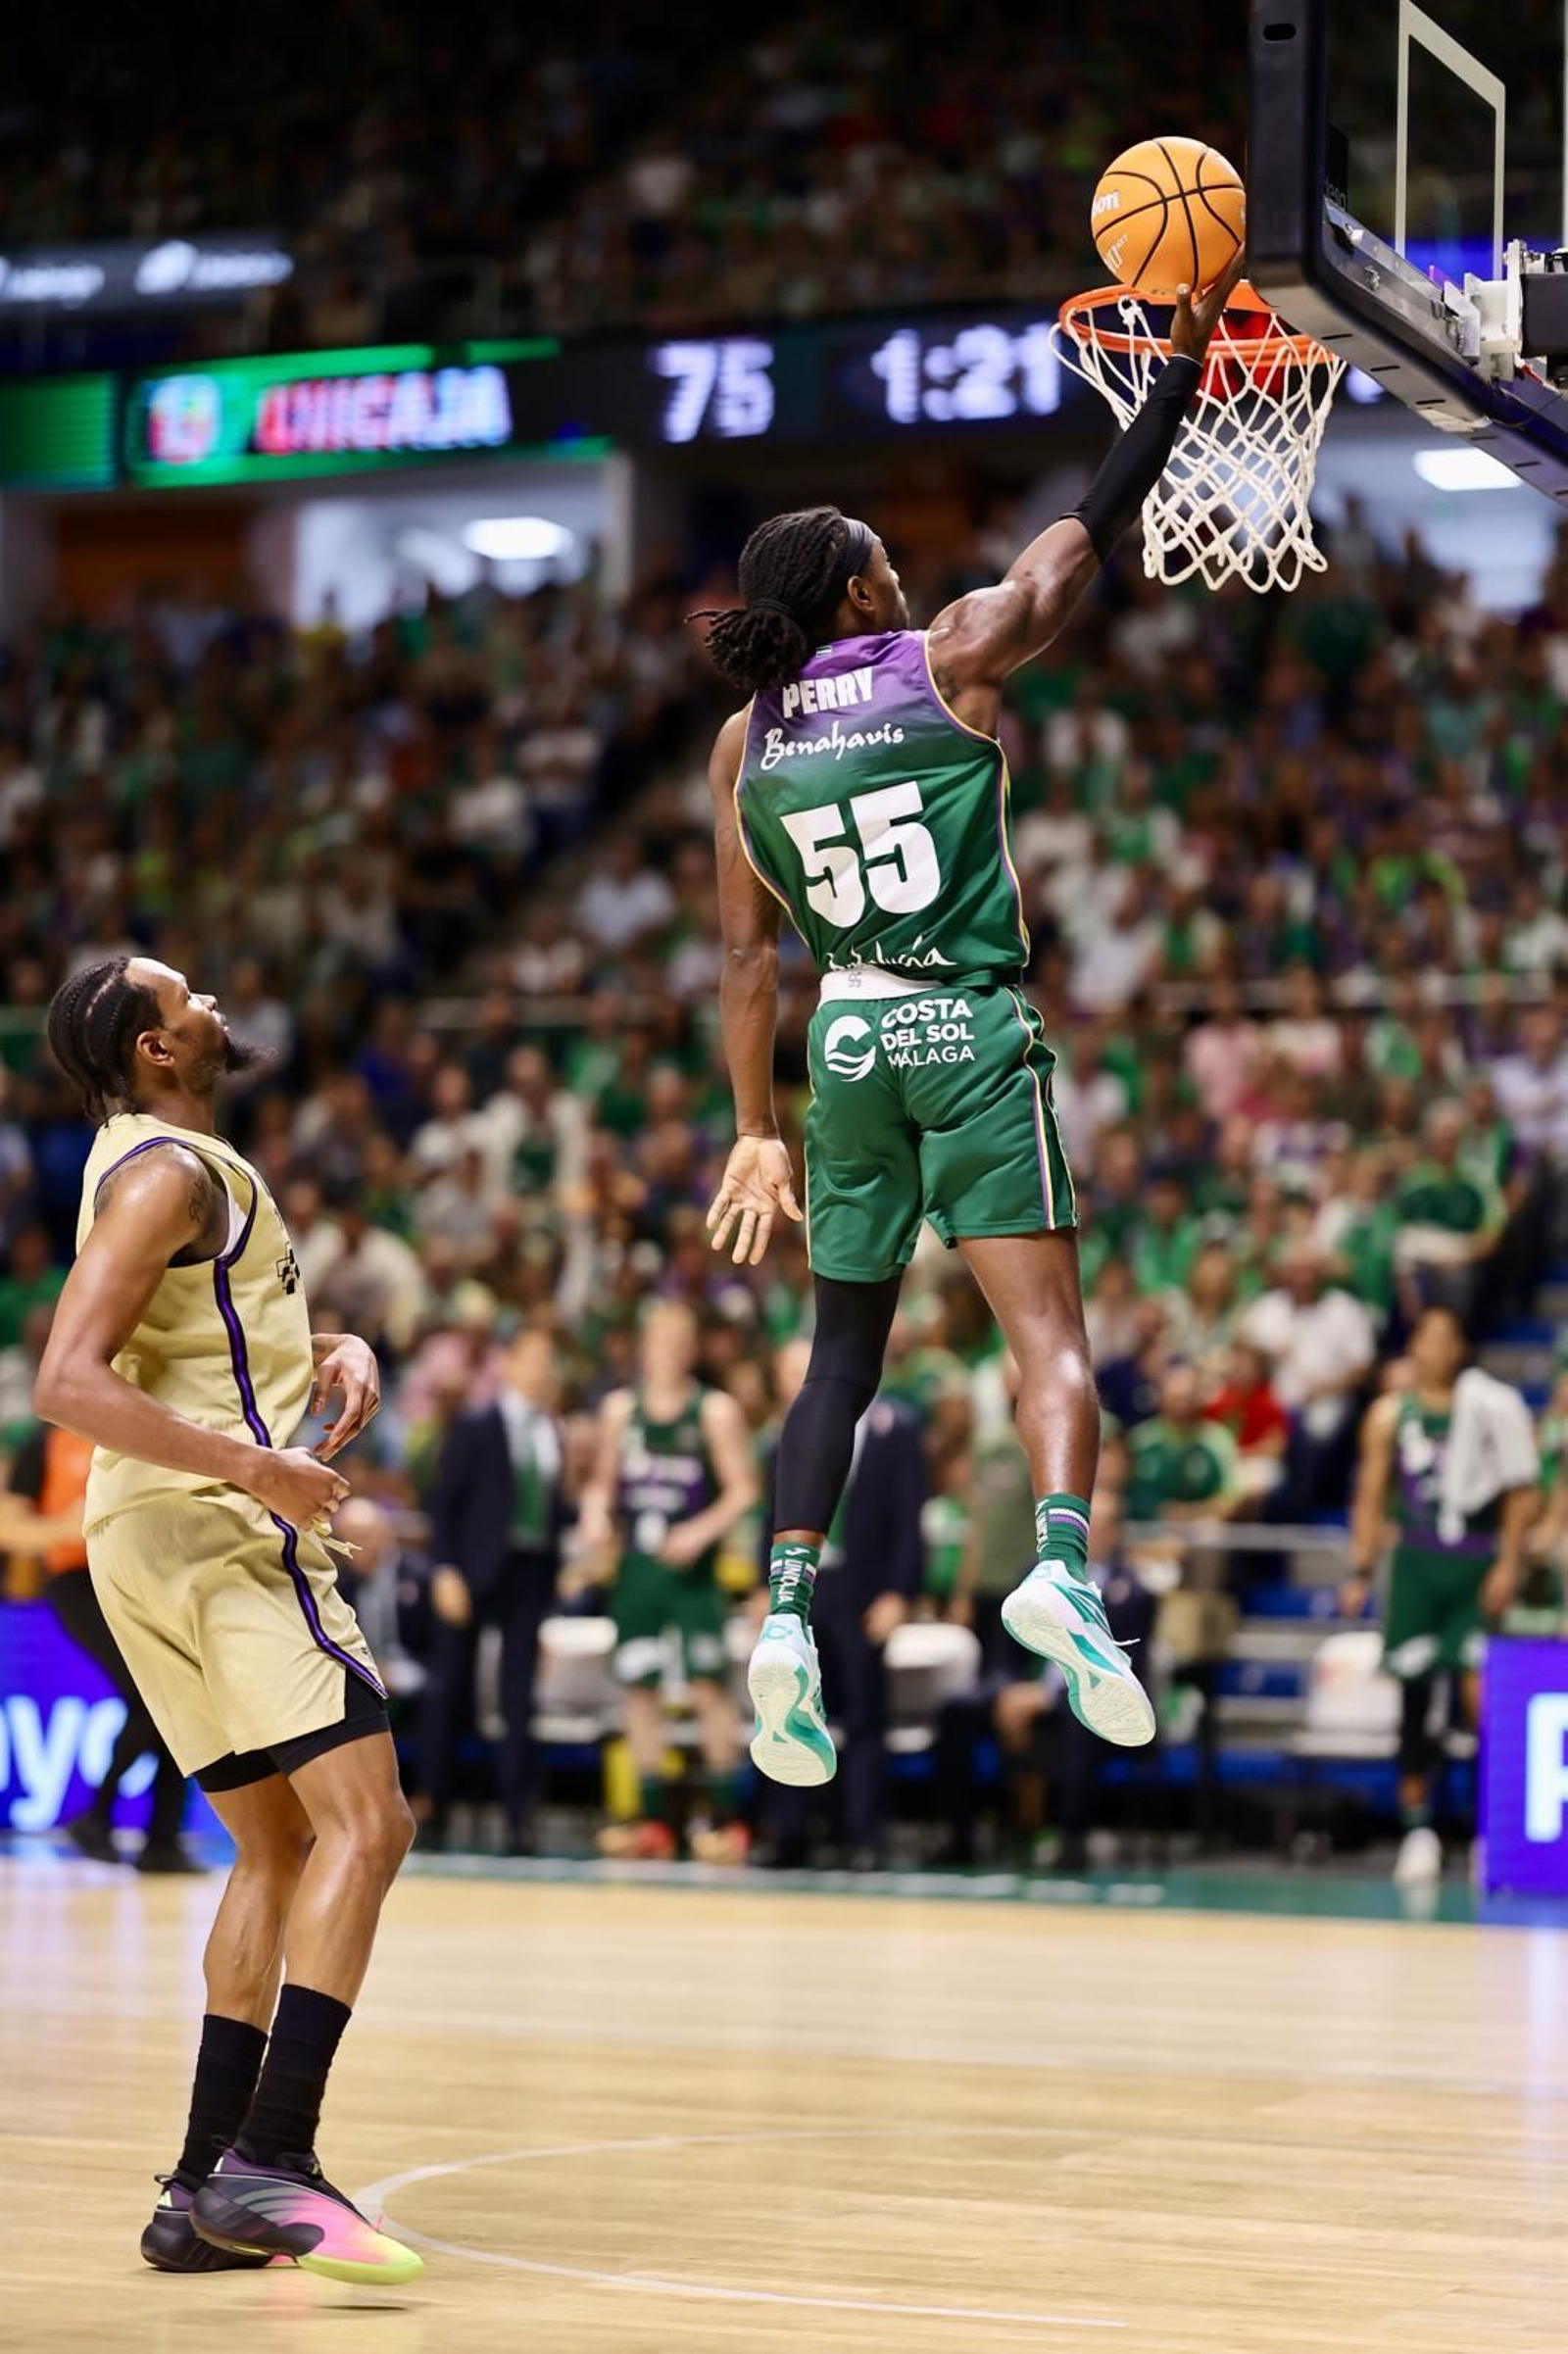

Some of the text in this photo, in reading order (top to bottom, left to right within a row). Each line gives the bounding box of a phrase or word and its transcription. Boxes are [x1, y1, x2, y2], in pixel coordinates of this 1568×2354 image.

[652, 338, 775, 445] 75
[871, 325, 1061, 423] 1:21
[782, 666, 873, 718] PERRY
[780, 780, 941, 929] 55
[881, 998, 973, 1029] COSTA
[881, 1023, 975, 1052] DEL SOL
[887, 1045, 976, 1069] MÁLAGA
